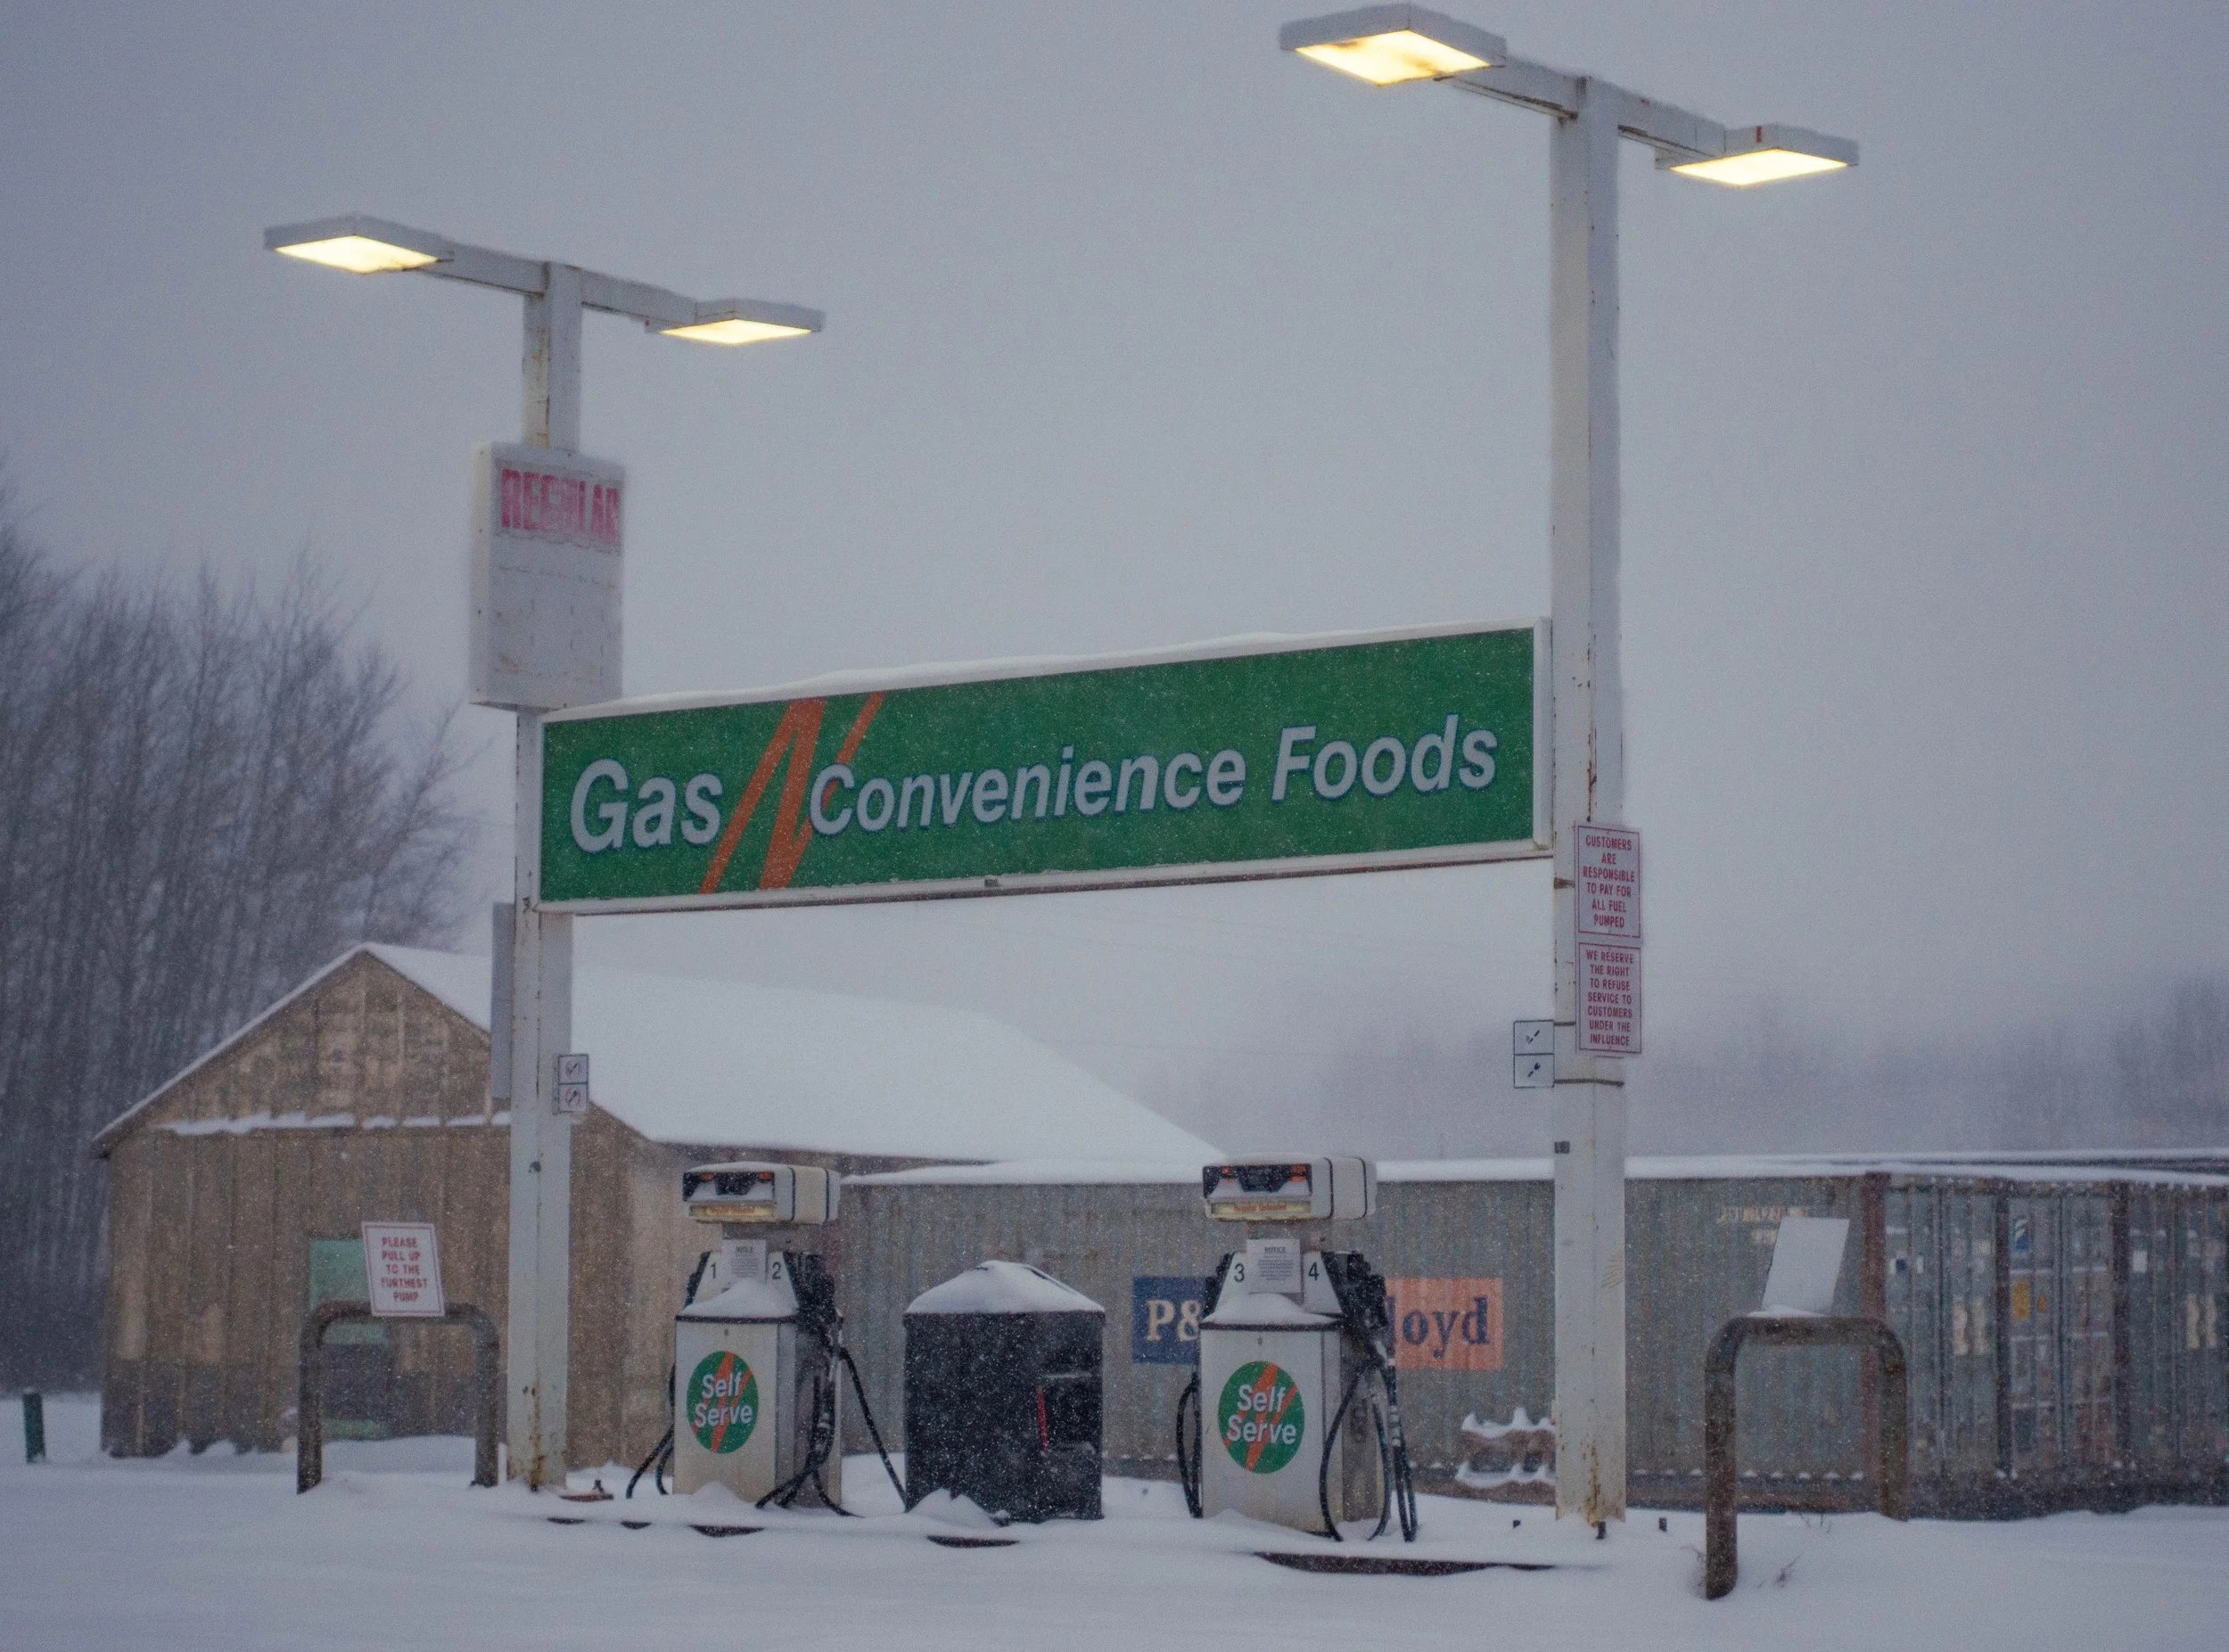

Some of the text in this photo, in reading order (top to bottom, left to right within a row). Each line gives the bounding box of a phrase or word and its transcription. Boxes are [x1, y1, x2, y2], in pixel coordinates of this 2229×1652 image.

[810, 714, 1498, 836] Convenience Foods
[570, 759, 723, 853] Gas
[1585, 834, 1632, 851] CUSTOMERS
[1601, 852, 1616, 865] ARE
[1583, 866, 1635, 883] RESPONSIBLE
[1587, 883, 1632, 898] TO PAY FOR
[1592, 899, 1626, 913] ALL FUEL
[1594, 914, 1624, 928] PUMPED
[1586, 949, 1634, 965] WE RESERVE
[1591, 964, 1630, 977] THE RIGHT
[1591, 977, 1631, 991] TO REFUSE
[1588, 991, 1633, 1005] SERVICE TO
[1588, 1006, 1633, 1019] CUSTOMERS
[1590, 1019, 1632, 1033] UNDER THE
[1591, 1033, 1631, 1047] INFLUENCE
[382, 1237, 417, 1248] PLEASE
[382, 1250, 420, 1262] PULL UP
[386, 1264, 420, 1275] TO THE
[710, 1262, 716, 1279] 1
[772, 1262, 782, 1279] 2
[1234, 1262, 1245, 1283] 3
[1308, 1262, 1320, 1281] 4
[382, 1277, 428, 1288] FURTHEST
[393, 1291, 418, 1303] PUMP
[702, 1371, 743, 1399] Self
[1237, 1384, 1286, 1413] Self
[695, 1402, 753, 1427] Serve
[1227, 1414, 1296, 1445] Serve
